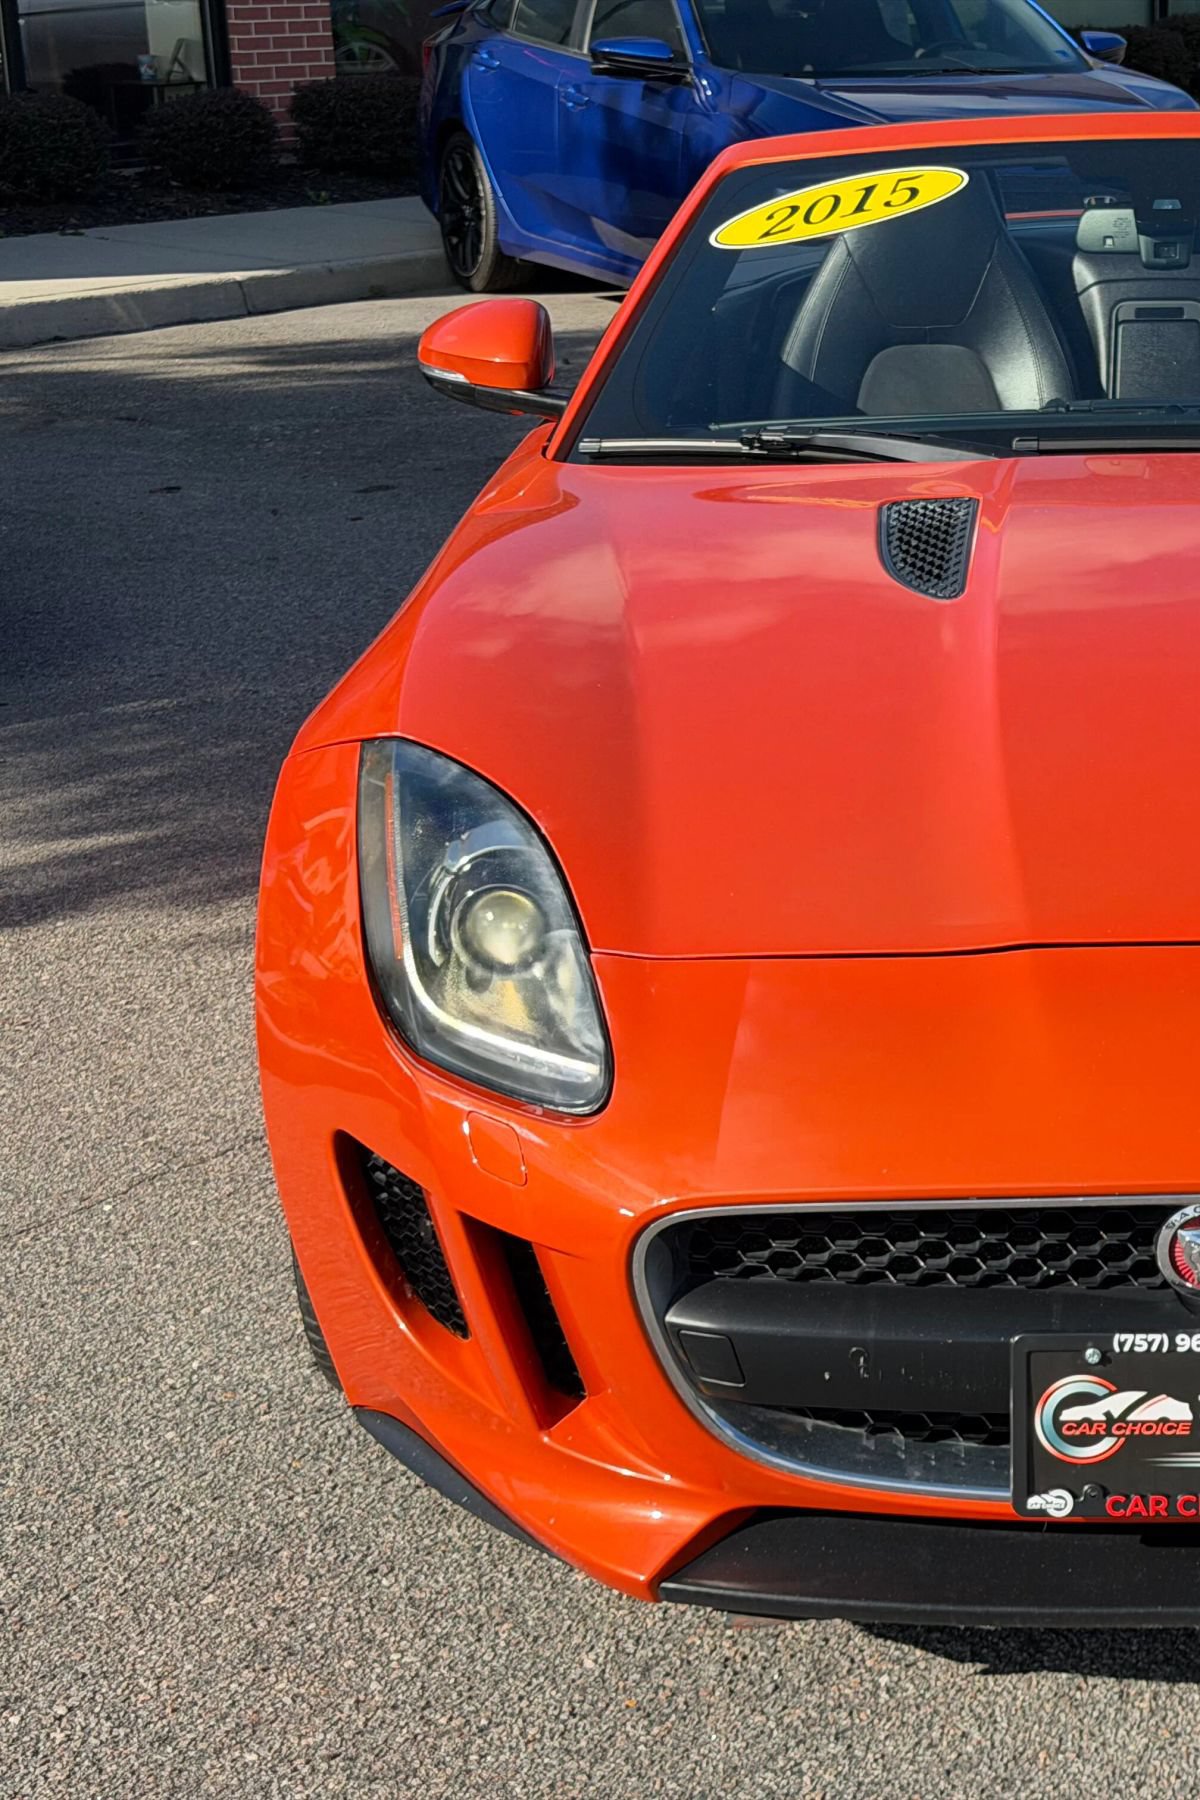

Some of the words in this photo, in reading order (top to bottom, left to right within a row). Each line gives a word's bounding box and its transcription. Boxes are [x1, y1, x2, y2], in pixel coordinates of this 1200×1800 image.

[757, 174, 925, 240] 2015
[1113, 1333, 1169, 1353] (757)
[1062, 1422, 1106, 1436] CAR
[1111, 1422, 1192, 1436] CHOICE
[1105, 1495, 1169, 1517] CAR
